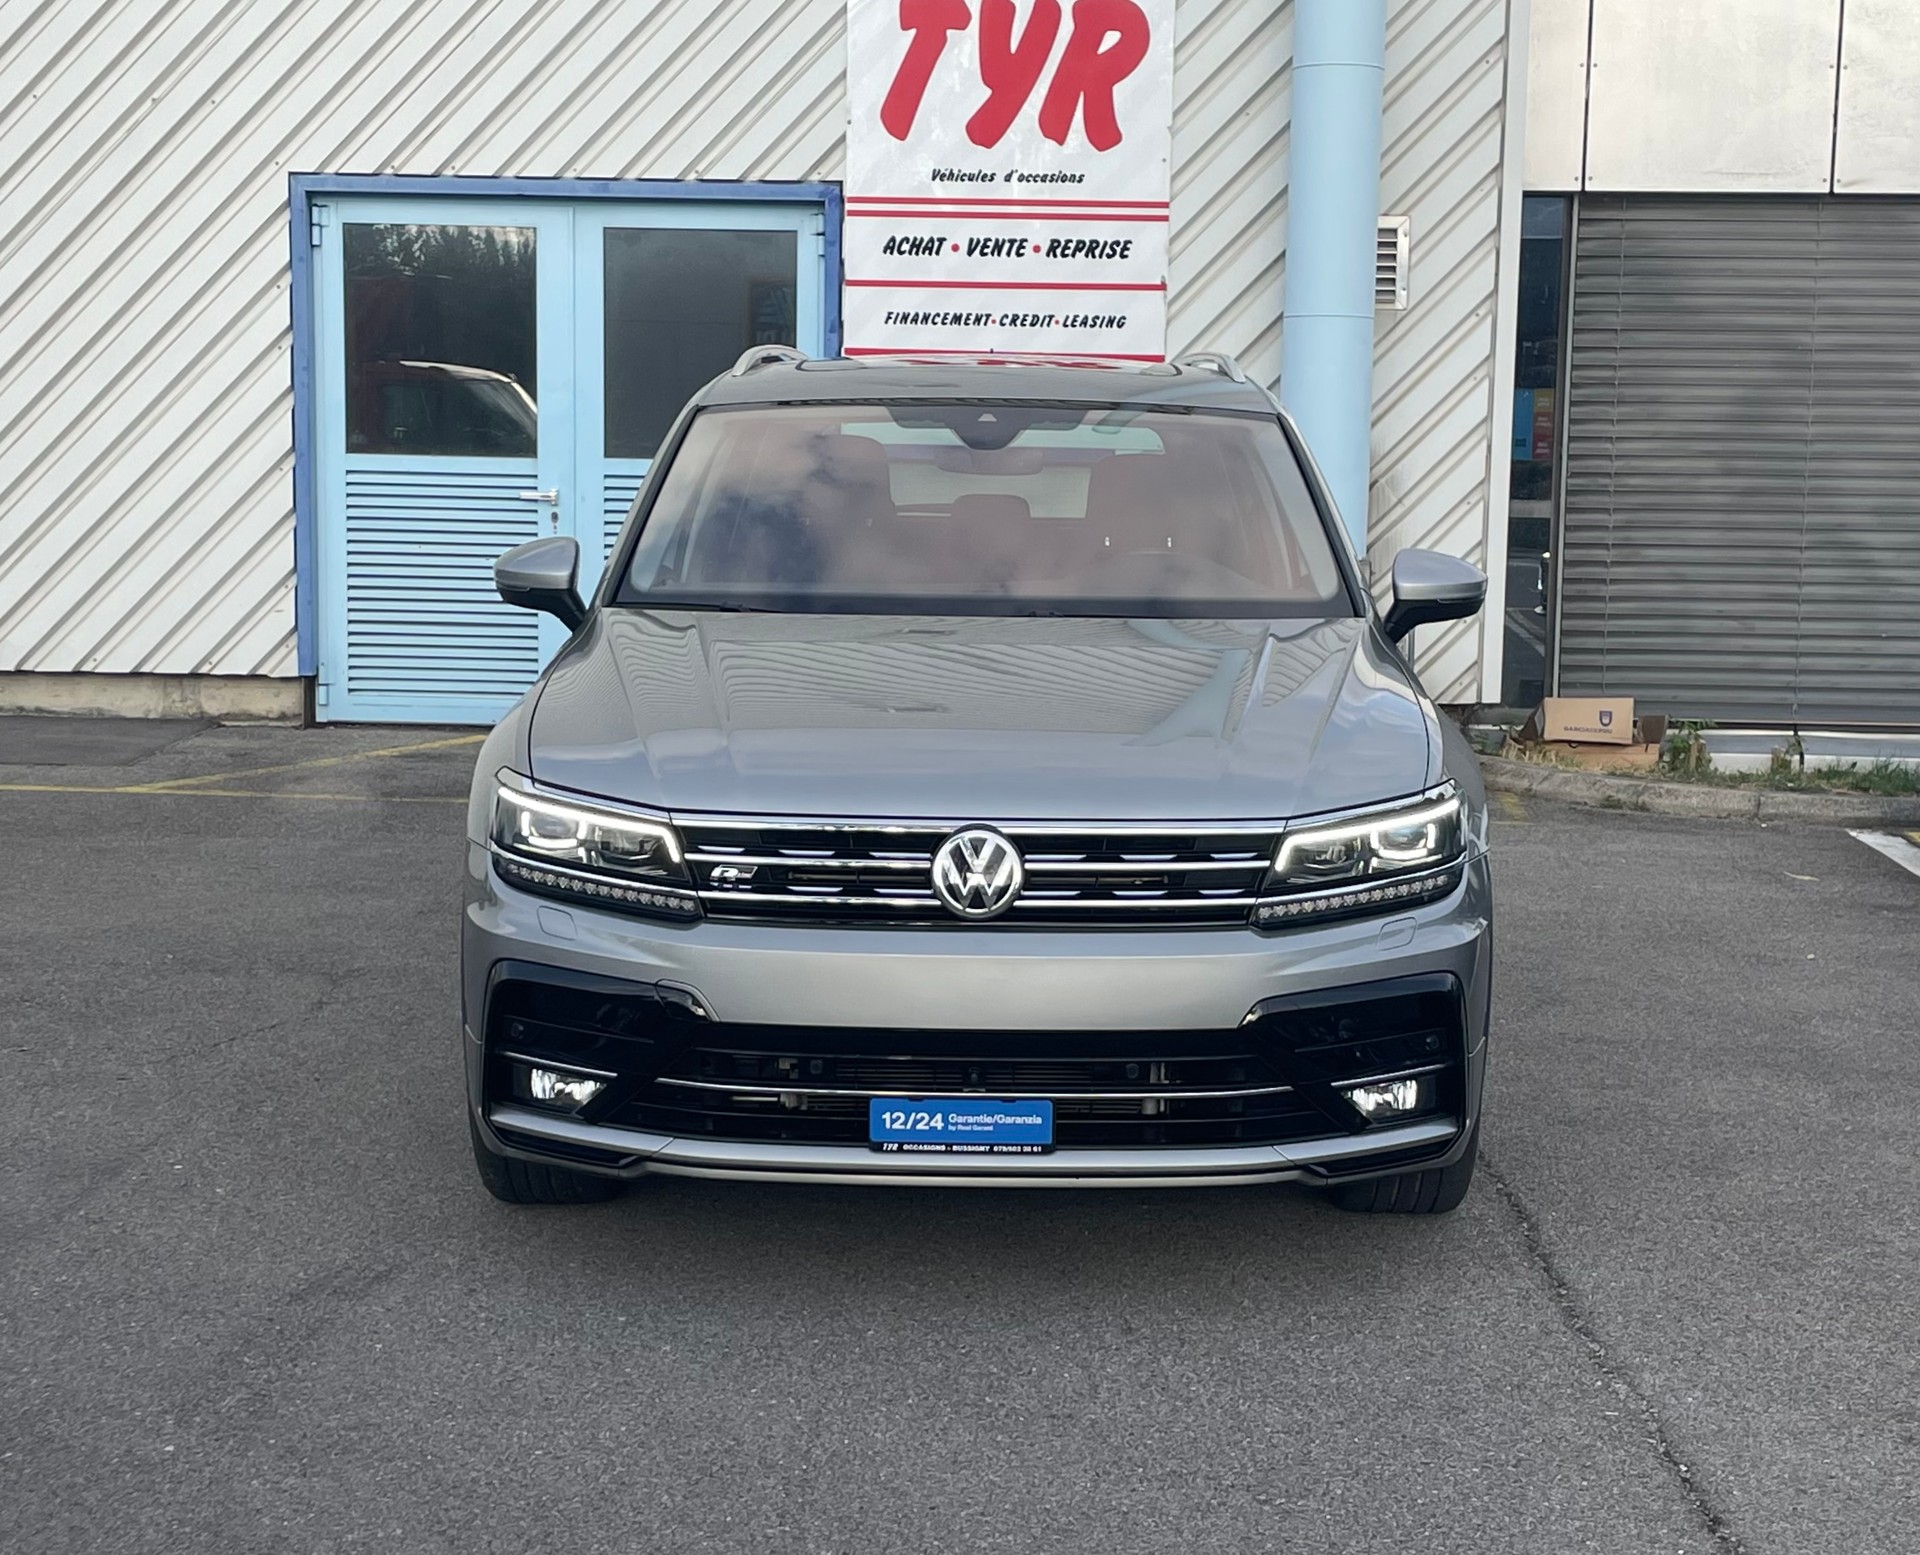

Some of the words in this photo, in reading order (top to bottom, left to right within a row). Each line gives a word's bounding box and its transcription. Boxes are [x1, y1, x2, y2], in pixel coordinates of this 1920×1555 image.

[881, 0, 1150, 152] TYR
[931, 168, 997, 184] Véhicules
[1004, 169, 1085, 185] d'occasions
[882, 235, 947, 257] ACHAT
[966, 236, 1029, 259] VENTE
[1046, 238, 1133, 260] REPRISE
[884, 311, 991, 328] FINANCEMENT
[998, 313, 1056, 329] CREDIT
[1062, 314, 1127, 330] LEASING
[881, 1111, 945, 1131] 12/24
[948, 1113, 1043, 1125] Garantie/Garanzia
